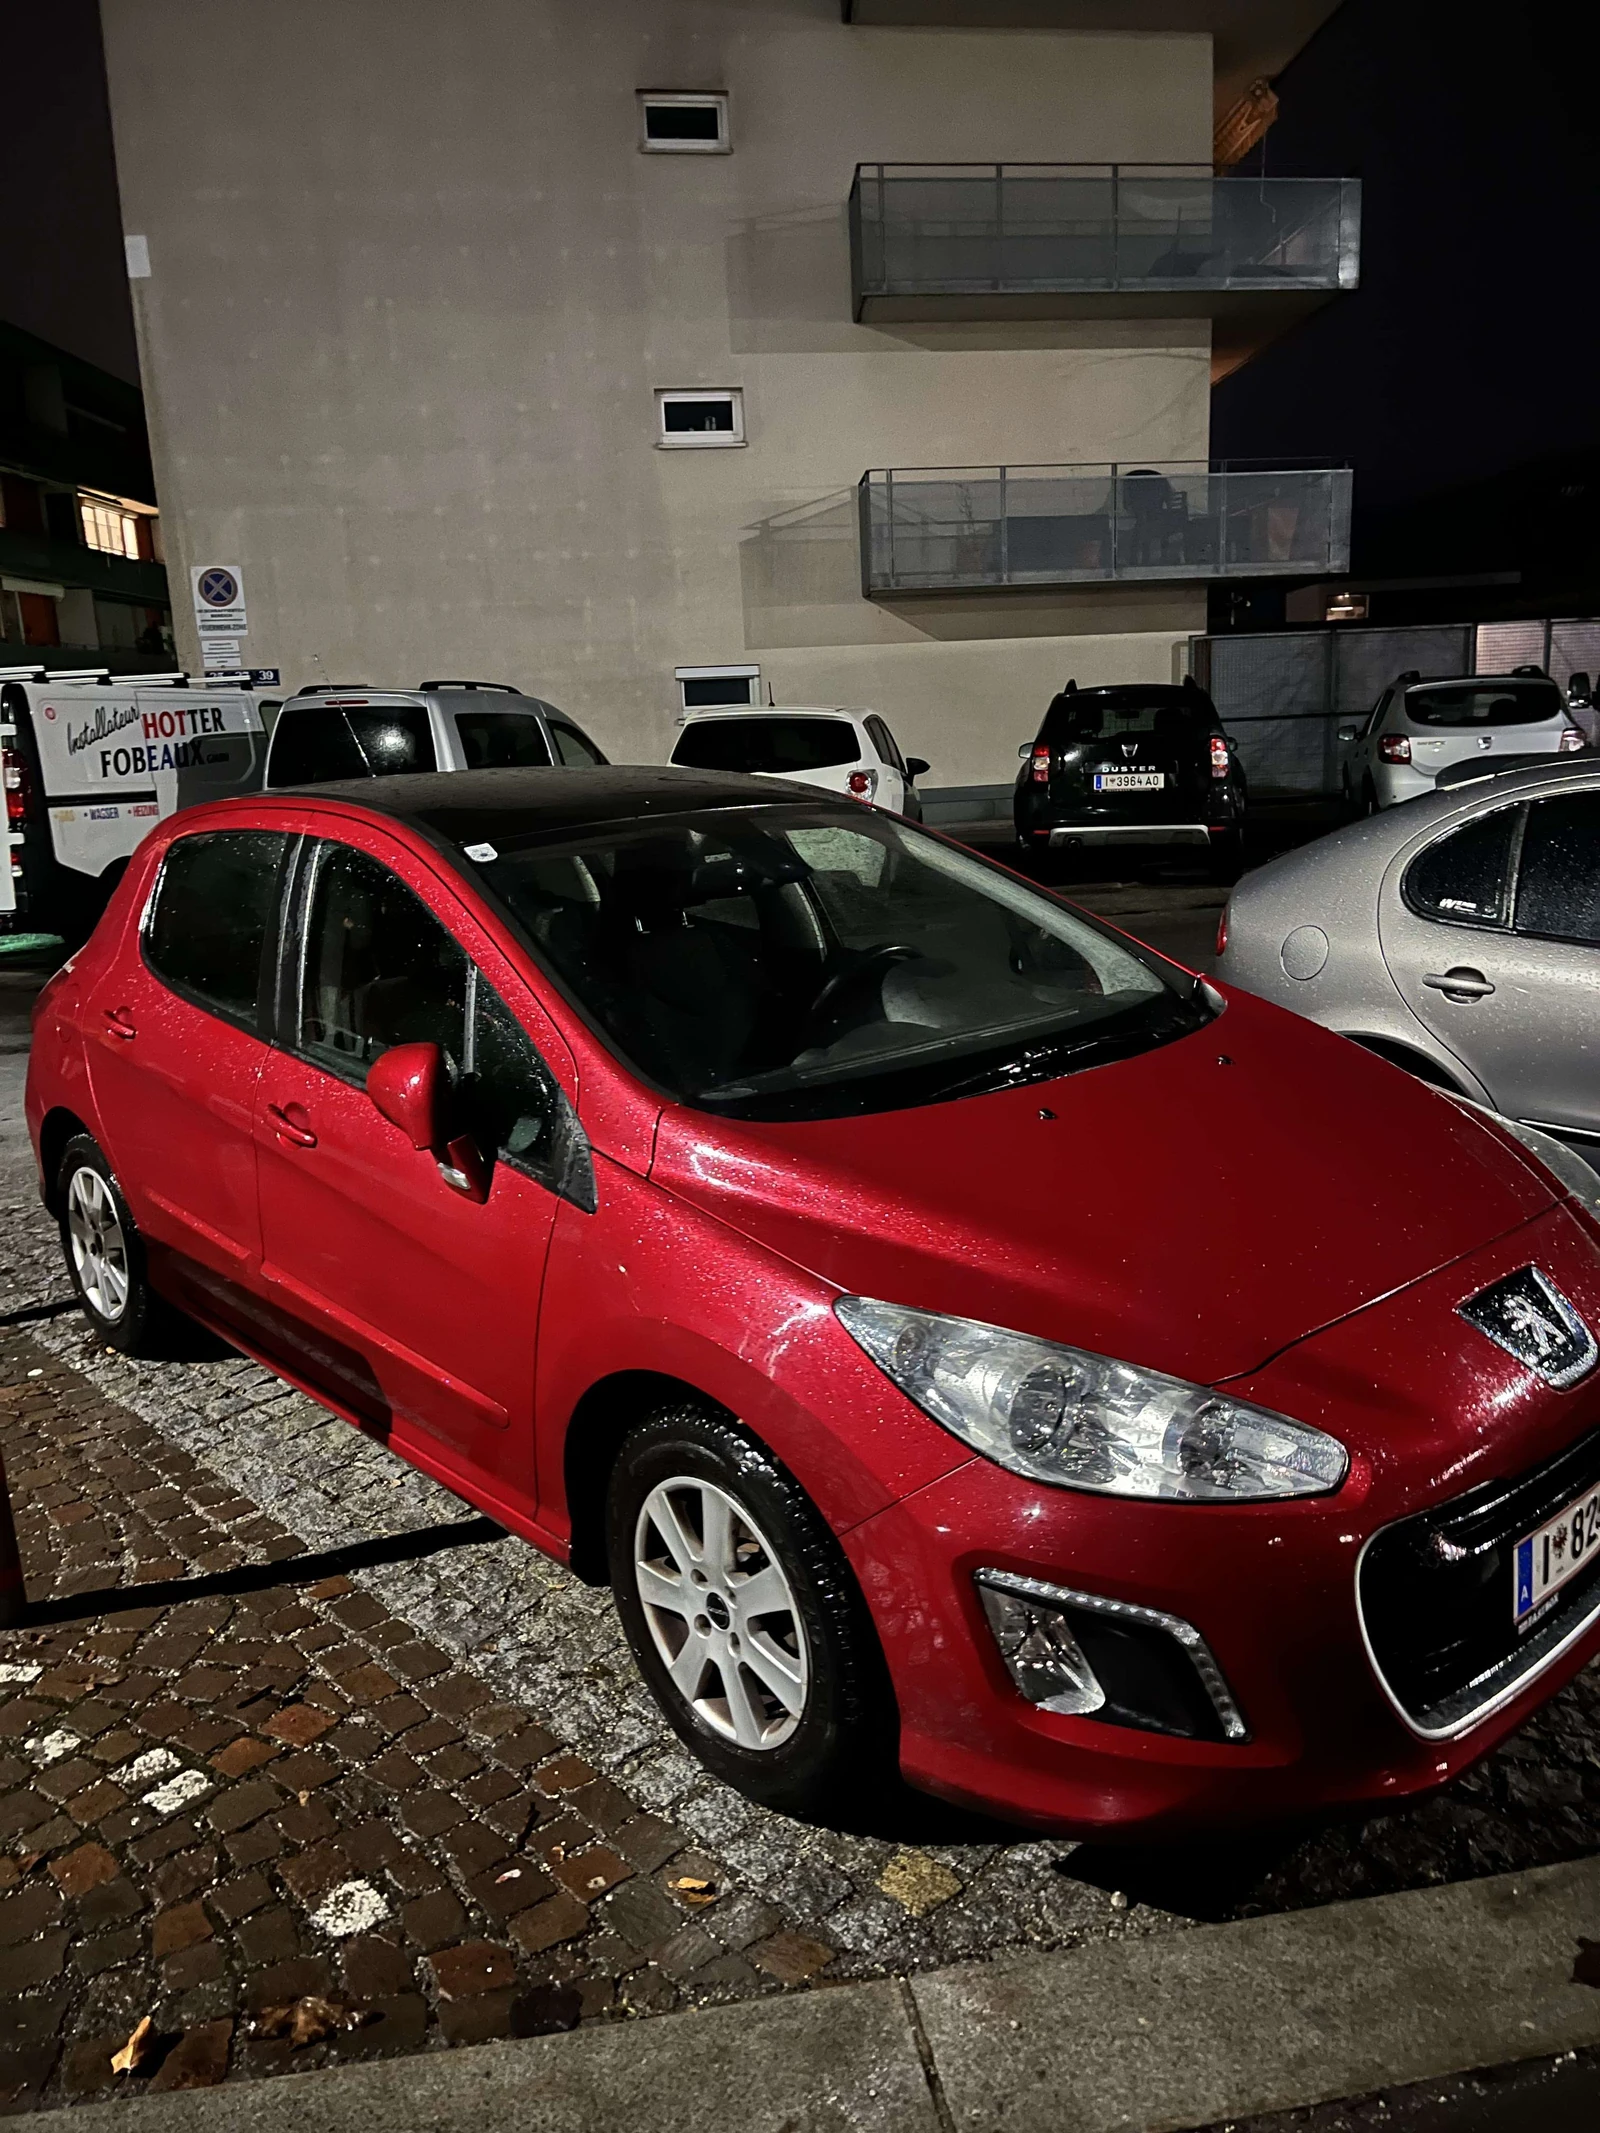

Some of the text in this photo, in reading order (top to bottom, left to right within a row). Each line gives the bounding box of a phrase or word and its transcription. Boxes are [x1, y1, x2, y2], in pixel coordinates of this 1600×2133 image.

[259, 670, 274, 680] 39
[67, 706, 226, 756] Installateur HOTTER
[101, 740, 205, 777] FOBEAUX
[1117, 775, 1142, 787] 3964
[1571, 1494, 1600, 1559] 82
